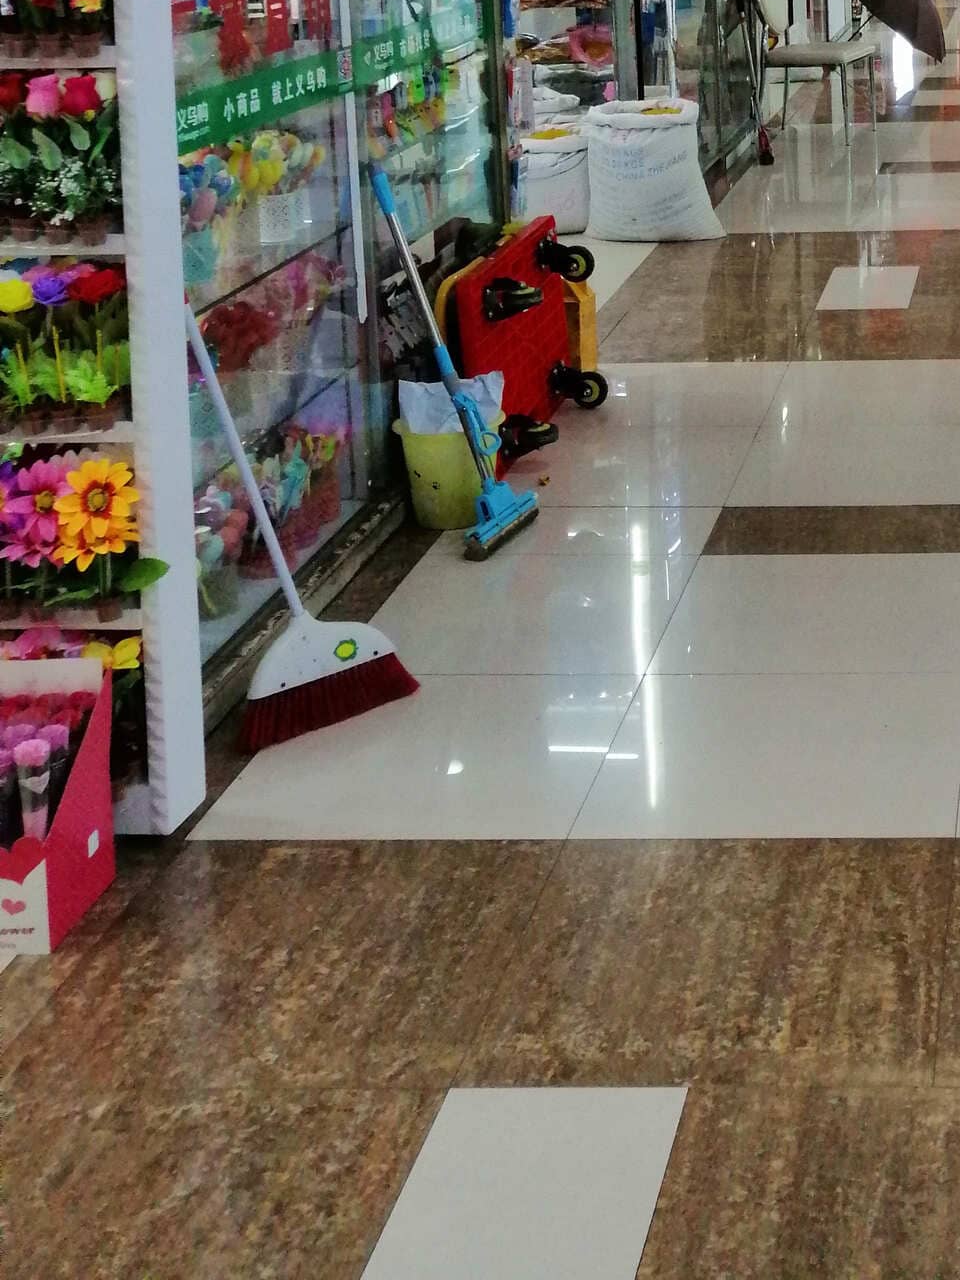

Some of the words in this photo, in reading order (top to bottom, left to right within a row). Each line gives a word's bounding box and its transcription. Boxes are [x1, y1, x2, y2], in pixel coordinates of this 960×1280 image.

[223, 87, 261, 122] 小商品
[271, 65, 327, 105] 就上义乌购
